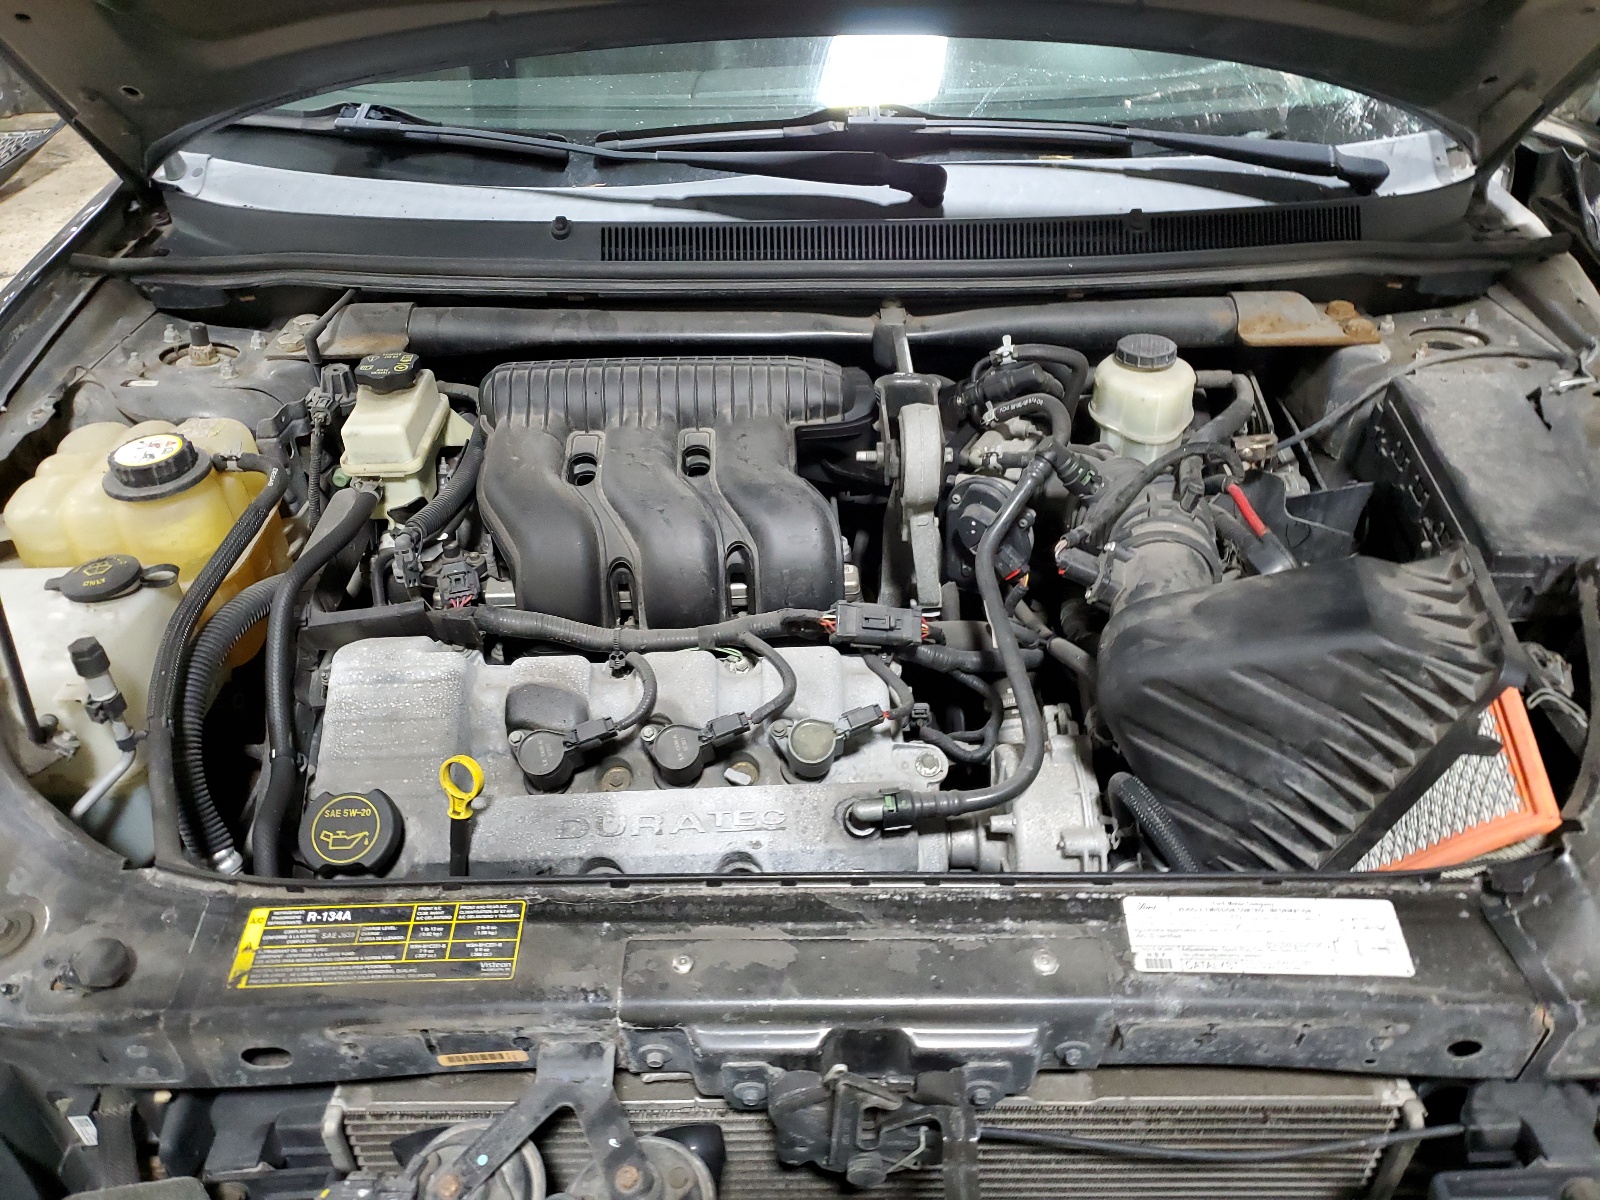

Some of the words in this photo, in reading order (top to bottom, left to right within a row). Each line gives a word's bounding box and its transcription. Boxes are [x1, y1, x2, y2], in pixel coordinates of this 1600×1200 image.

[82, 577, 106, 587] ONLY
[324, 809, 342, 818] SAE
[342, 808, 372, 818] 5W-20
[554, 809, 788, 840] DURATEC
[306, 910, 352, 923] R-134A
